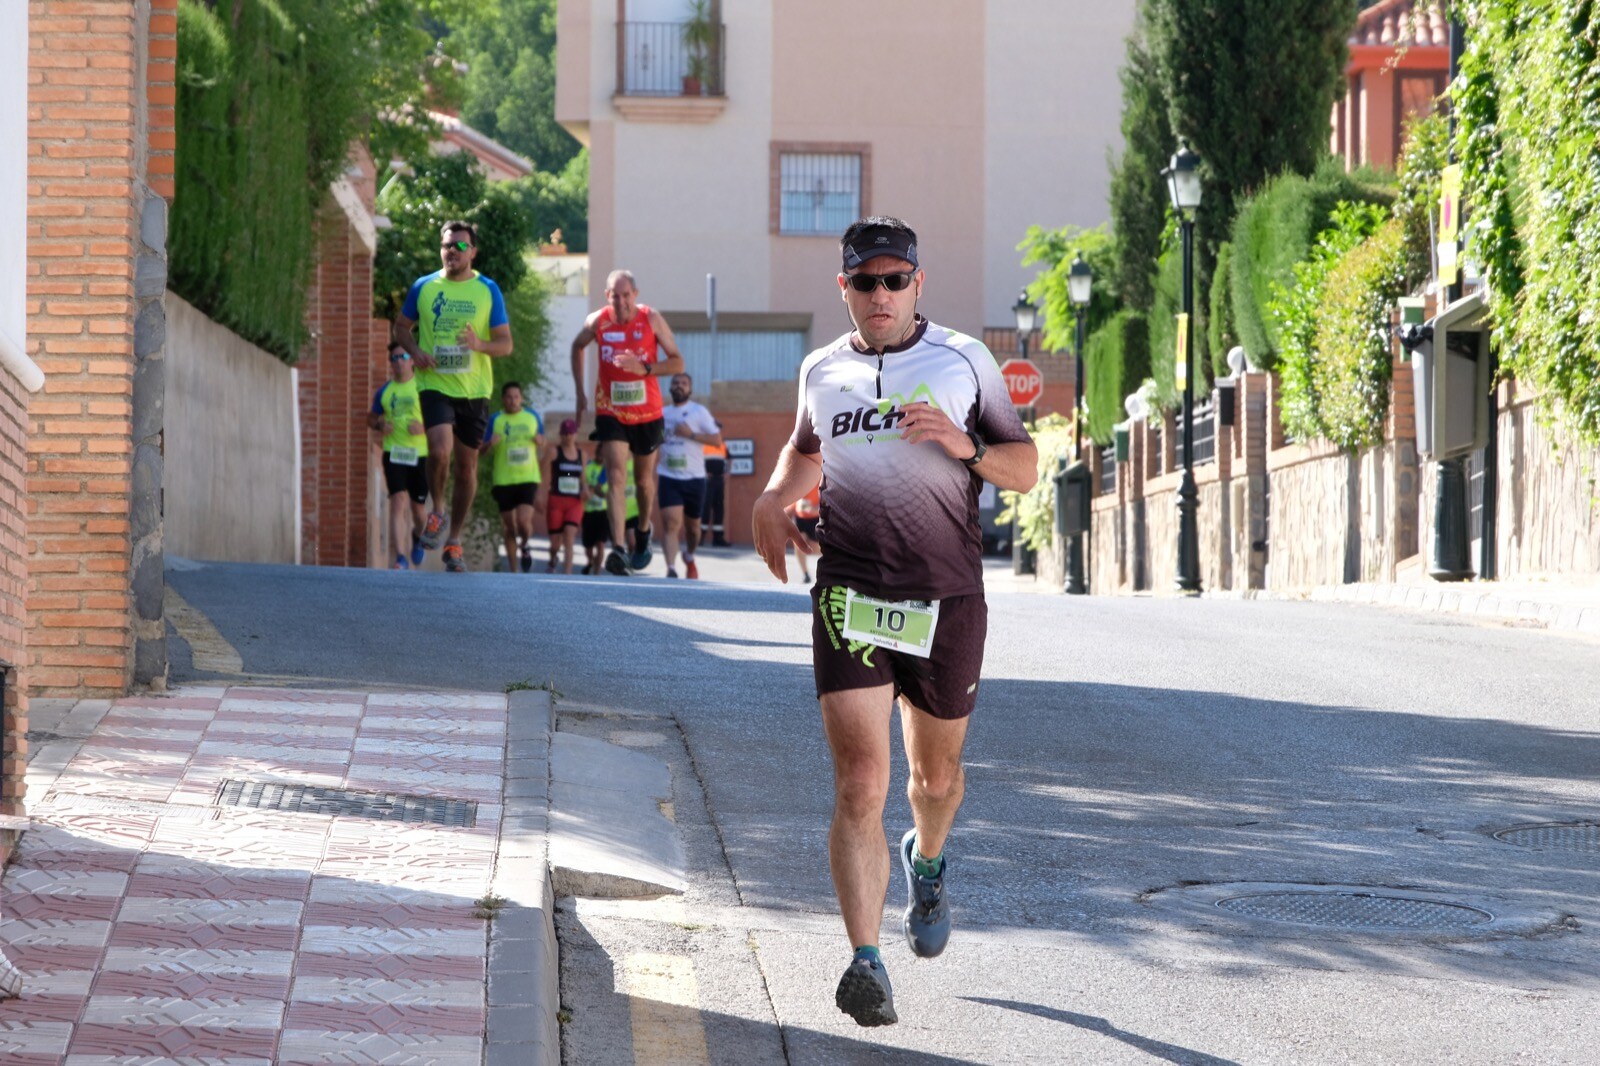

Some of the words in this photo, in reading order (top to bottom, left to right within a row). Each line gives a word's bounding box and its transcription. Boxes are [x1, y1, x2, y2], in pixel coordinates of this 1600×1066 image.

[440, 355, 463, 366] 212
[616, 390, 639, 400] 387
[874, 607, 906, 632] 10
[873, 637, 893, 647] helvetia
